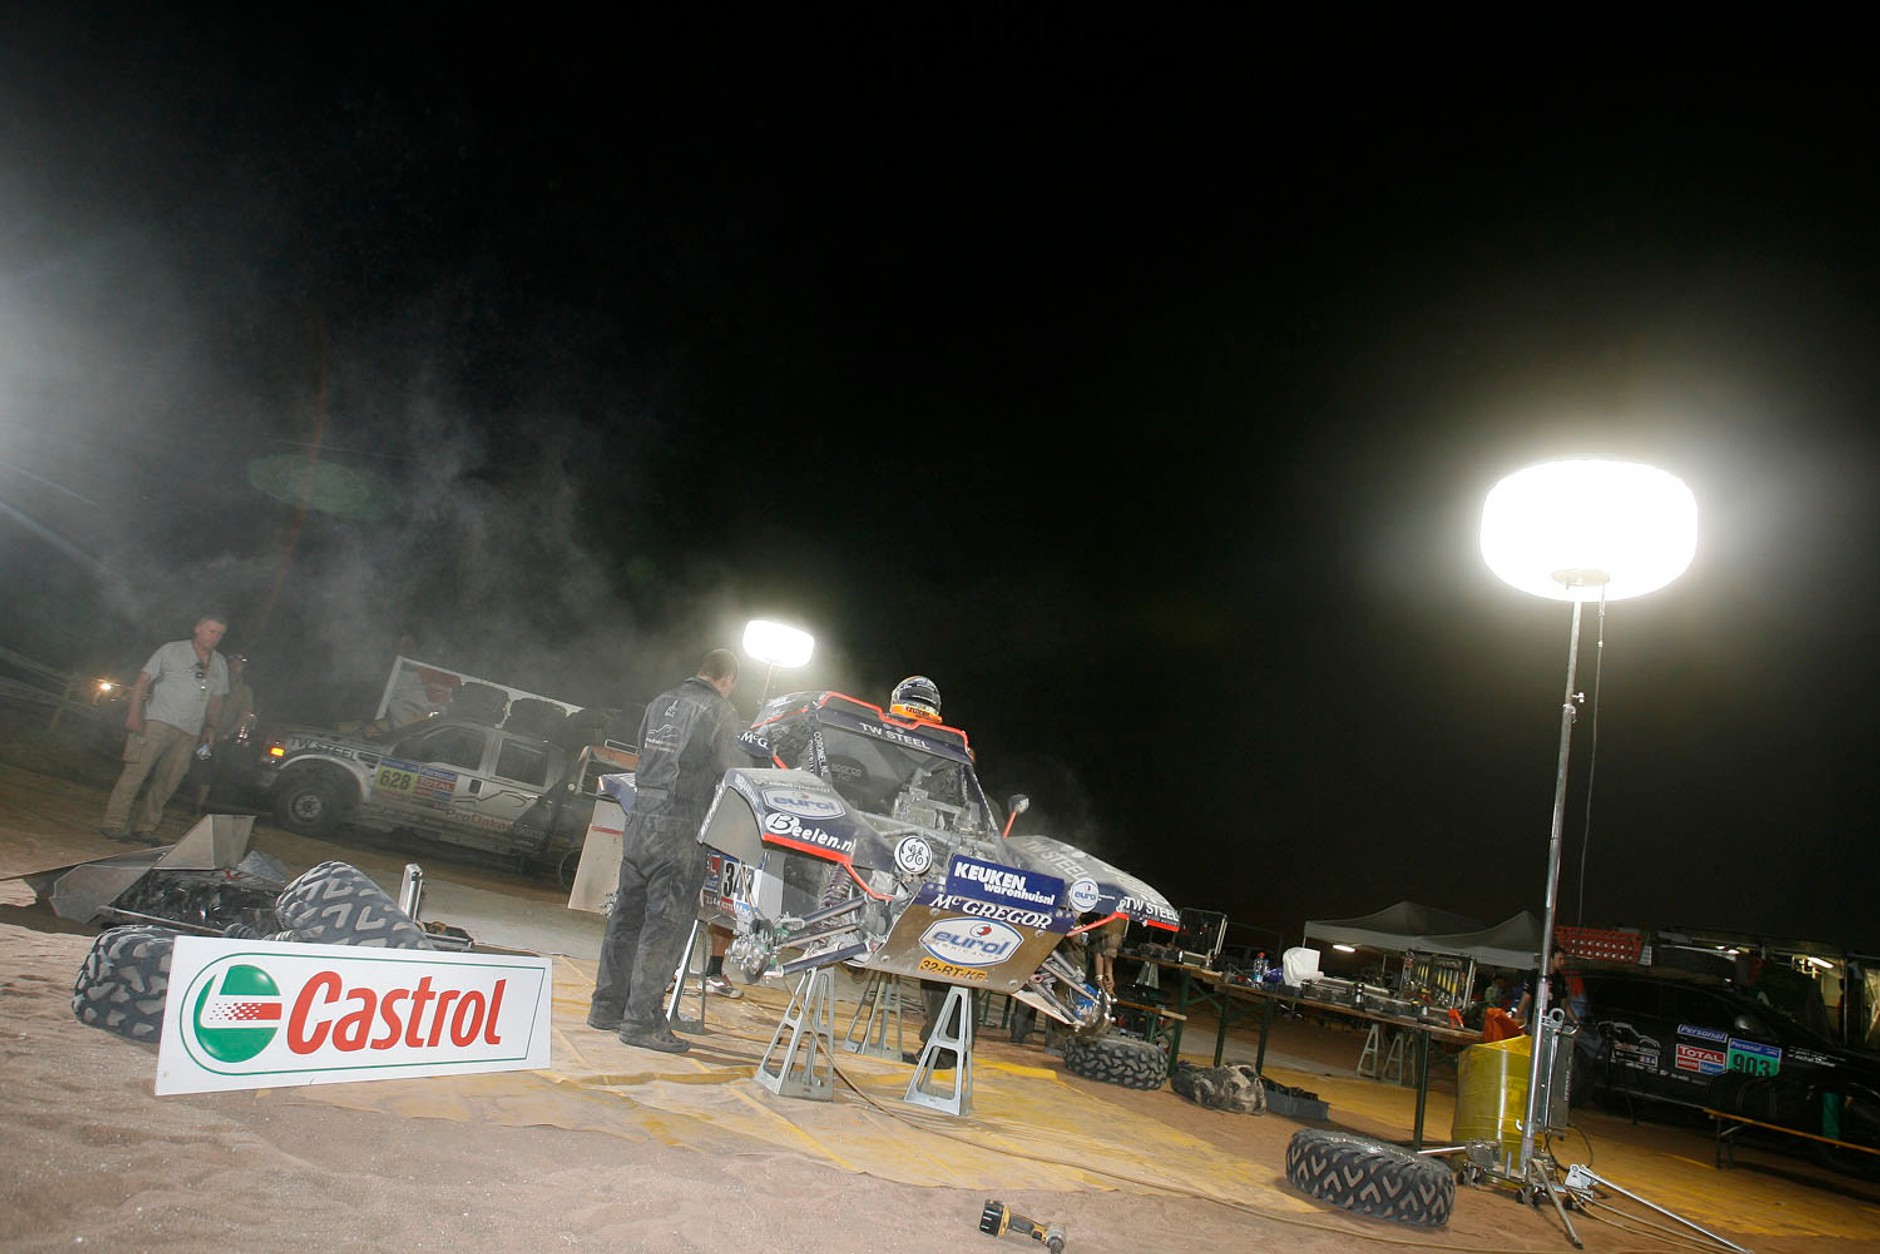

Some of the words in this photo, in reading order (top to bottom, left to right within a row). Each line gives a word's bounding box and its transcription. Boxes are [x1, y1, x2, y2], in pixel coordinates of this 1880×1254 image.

[860, 722, 882, 736] TW
[885, 730, 931, 750] STEEL
[380, 769, 412, 790] 628
[954, 861, 1027, 891] KEUKEN
[1124, 896, 1144, 912] TW
[1145, 901, 1180, 922] STEEL
[932, 930, 1012, 956] eurol
[286, 970, 507, 1056] Castrol
[1680, 1025, 1725, 1042] Personal
[1679, 1047, 1722, 1063] TOTAL
